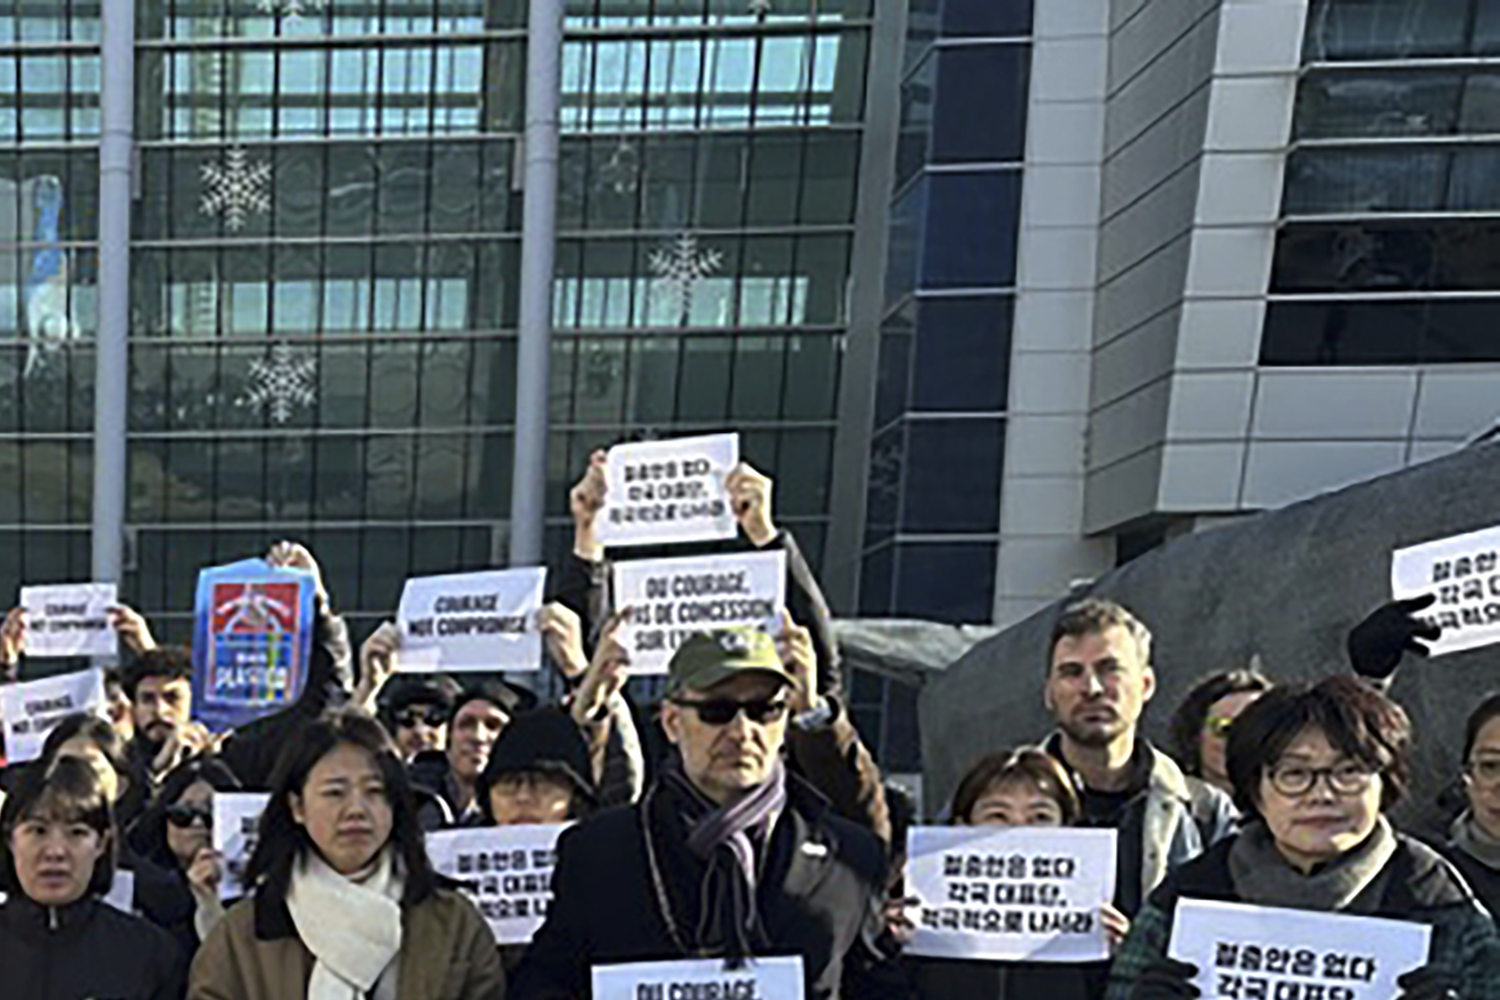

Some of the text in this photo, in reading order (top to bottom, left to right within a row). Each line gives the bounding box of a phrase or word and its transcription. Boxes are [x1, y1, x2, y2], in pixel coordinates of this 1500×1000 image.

[434, 593, 499, 613] COURAGE
[655, 602, 674, 625] DE
[678, 600, 774, 623] CONCESSION
[409, 616, 527, 636] NOT COMPROMISE
[634, 629, 665, 651] SUR
[1032, 856, 1075, 878] 없다
[948, 883, 989, 904] 각국
[920, 907, 1094, 934] 적극적으로 나서라
[1215, 941, 1376, 982] 절충안은 없다
